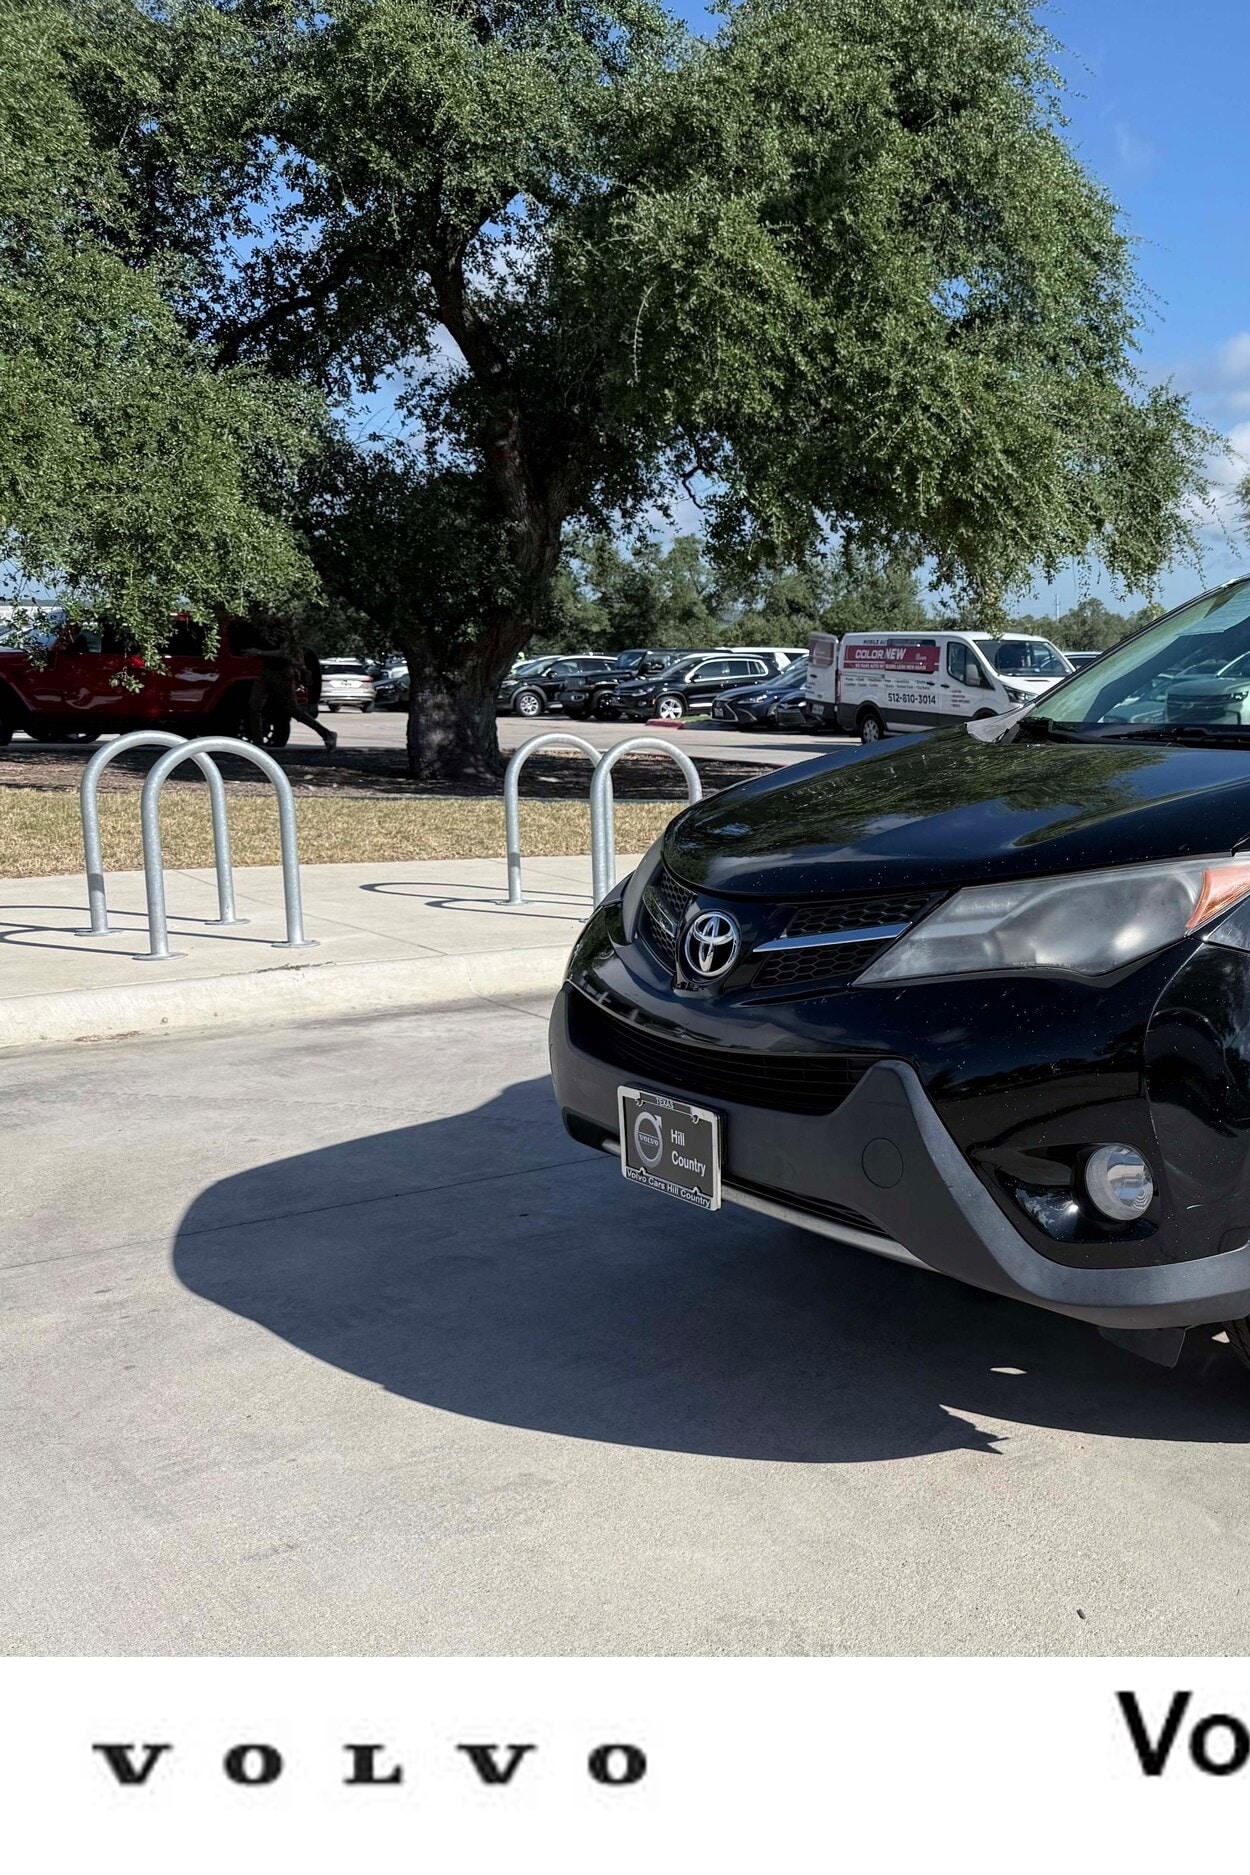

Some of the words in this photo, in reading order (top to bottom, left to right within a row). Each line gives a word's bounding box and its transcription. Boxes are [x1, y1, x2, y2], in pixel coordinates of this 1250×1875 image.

[855, 649, 884, 659] COLOR
[884, 648, 906, 660] NEW
[888, 692, 936, 705] 512-810-3014
[656, 1097, 675, 1110] TEXAS
[638, 1134, 659, 1146] VOLVO
[670, 1129, 685, 1147] Hill
[671, 1150, 706, 1177] Country
[627, 1170, 647, 1183] Volvo
[648, 1177, 665, 1190] Cars
[667, 1183, 679, 1195] Hill
[680, 1189, 711, 1208] Country
